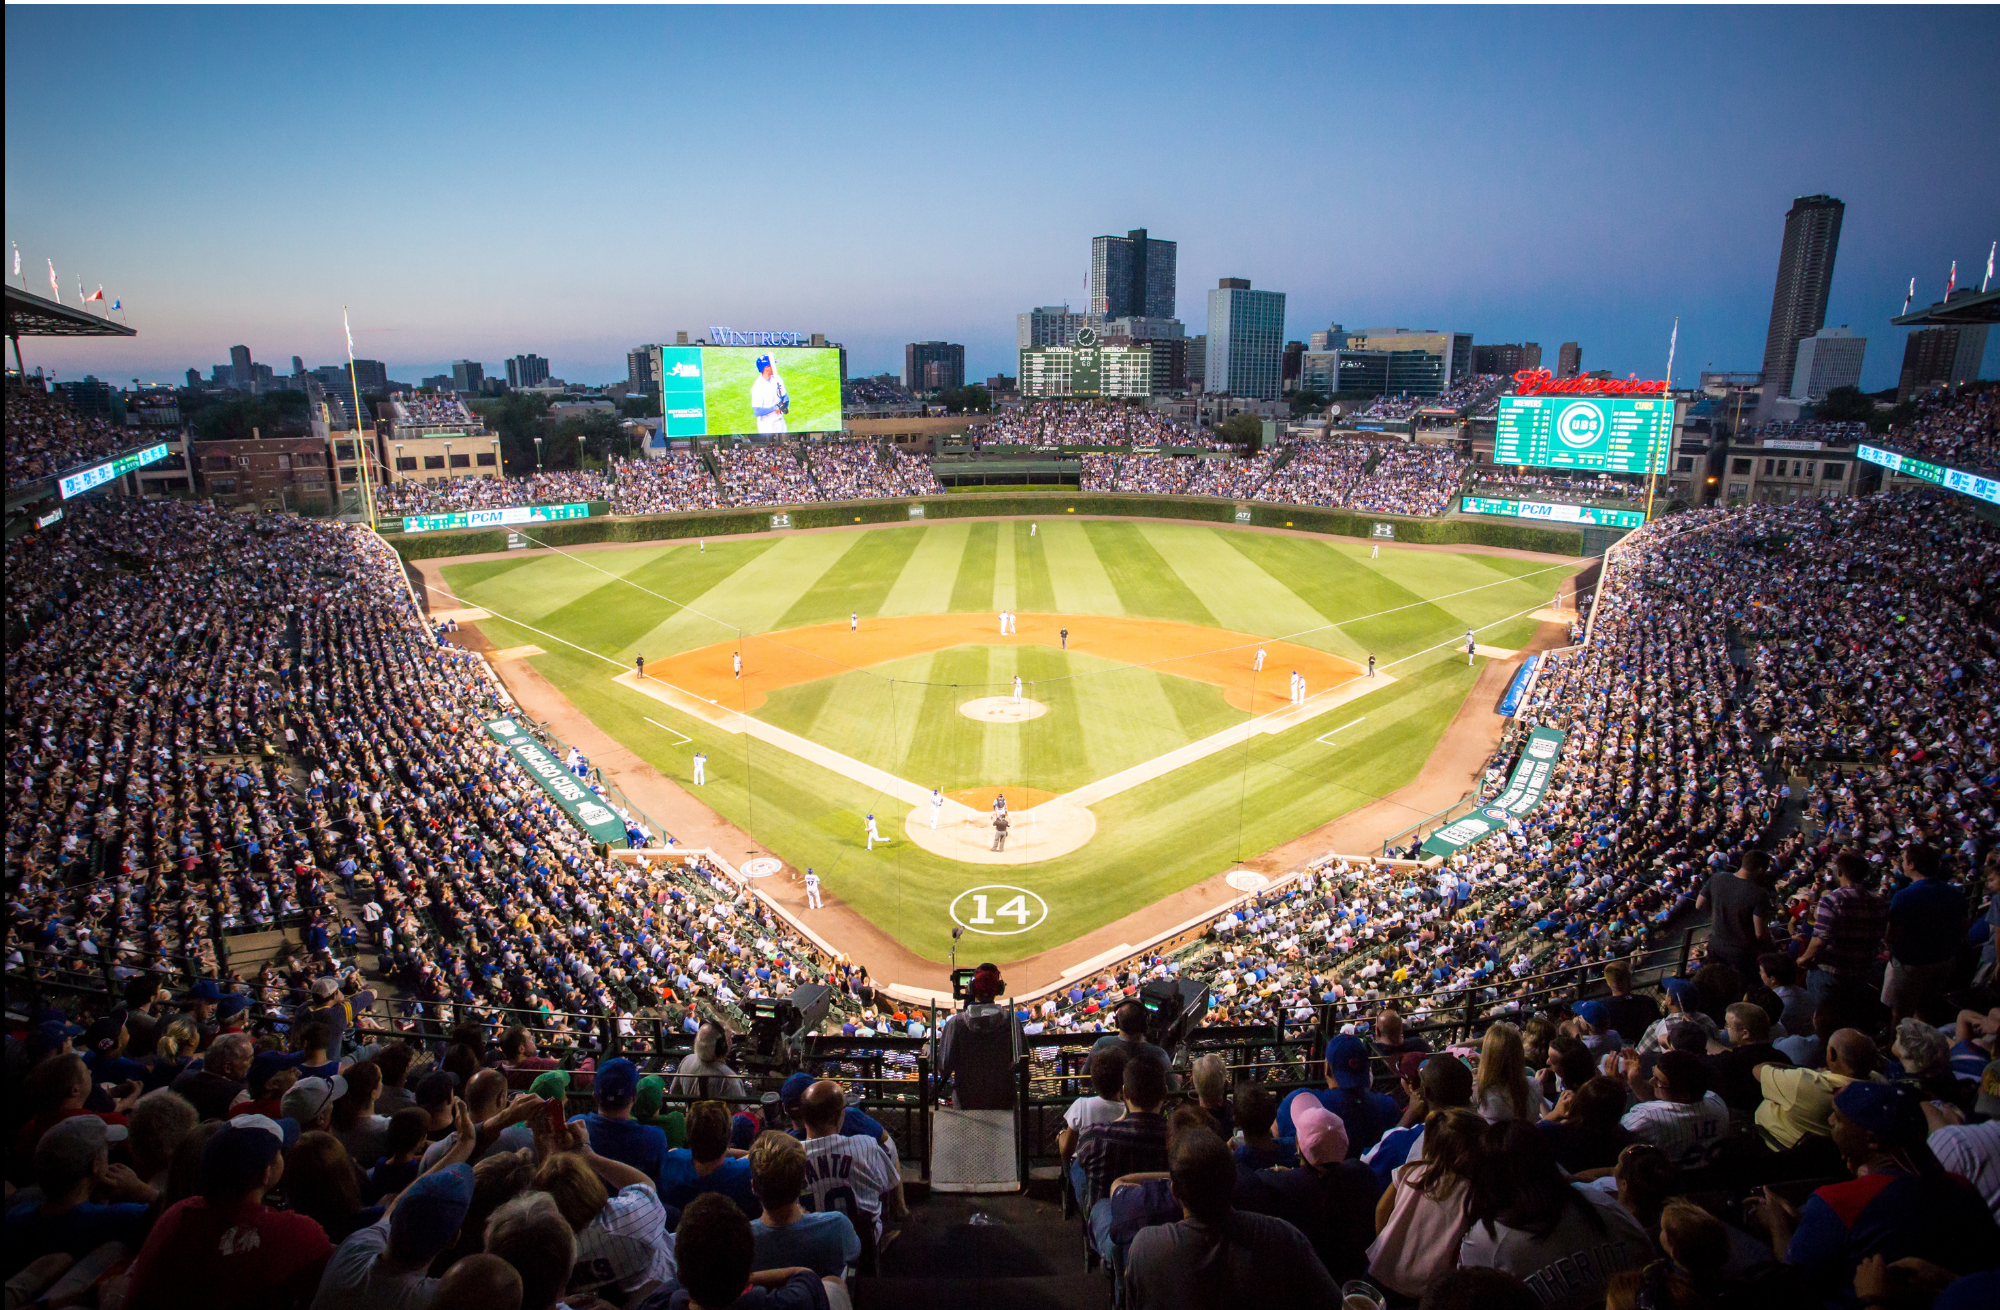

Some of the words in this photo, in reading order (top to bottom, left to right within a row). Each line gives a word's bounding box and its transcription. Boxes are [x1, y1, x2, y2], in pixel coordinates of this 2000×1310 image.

[709, 326, 801, 346] WINTRUST
[1513, 369, 1671, 395] Budweiser
[1513, 399, 1542, 407] BREWERS
[1634, 402, 1654, 410] CUBS
[471, 512, 503, 523] PCM
[1521, 504, 1552, 516] PCM
[516, 744, 562, 778] CHICAGO
[549, 776, 586, 801] CUBS
[969, 894, 1030, 924] 14
[1692, 1120, 1718, 1139] LEE
[804, 1153, 852, 1184] ANTO
[1523, 1242, 1626, 1305] THERIOT
